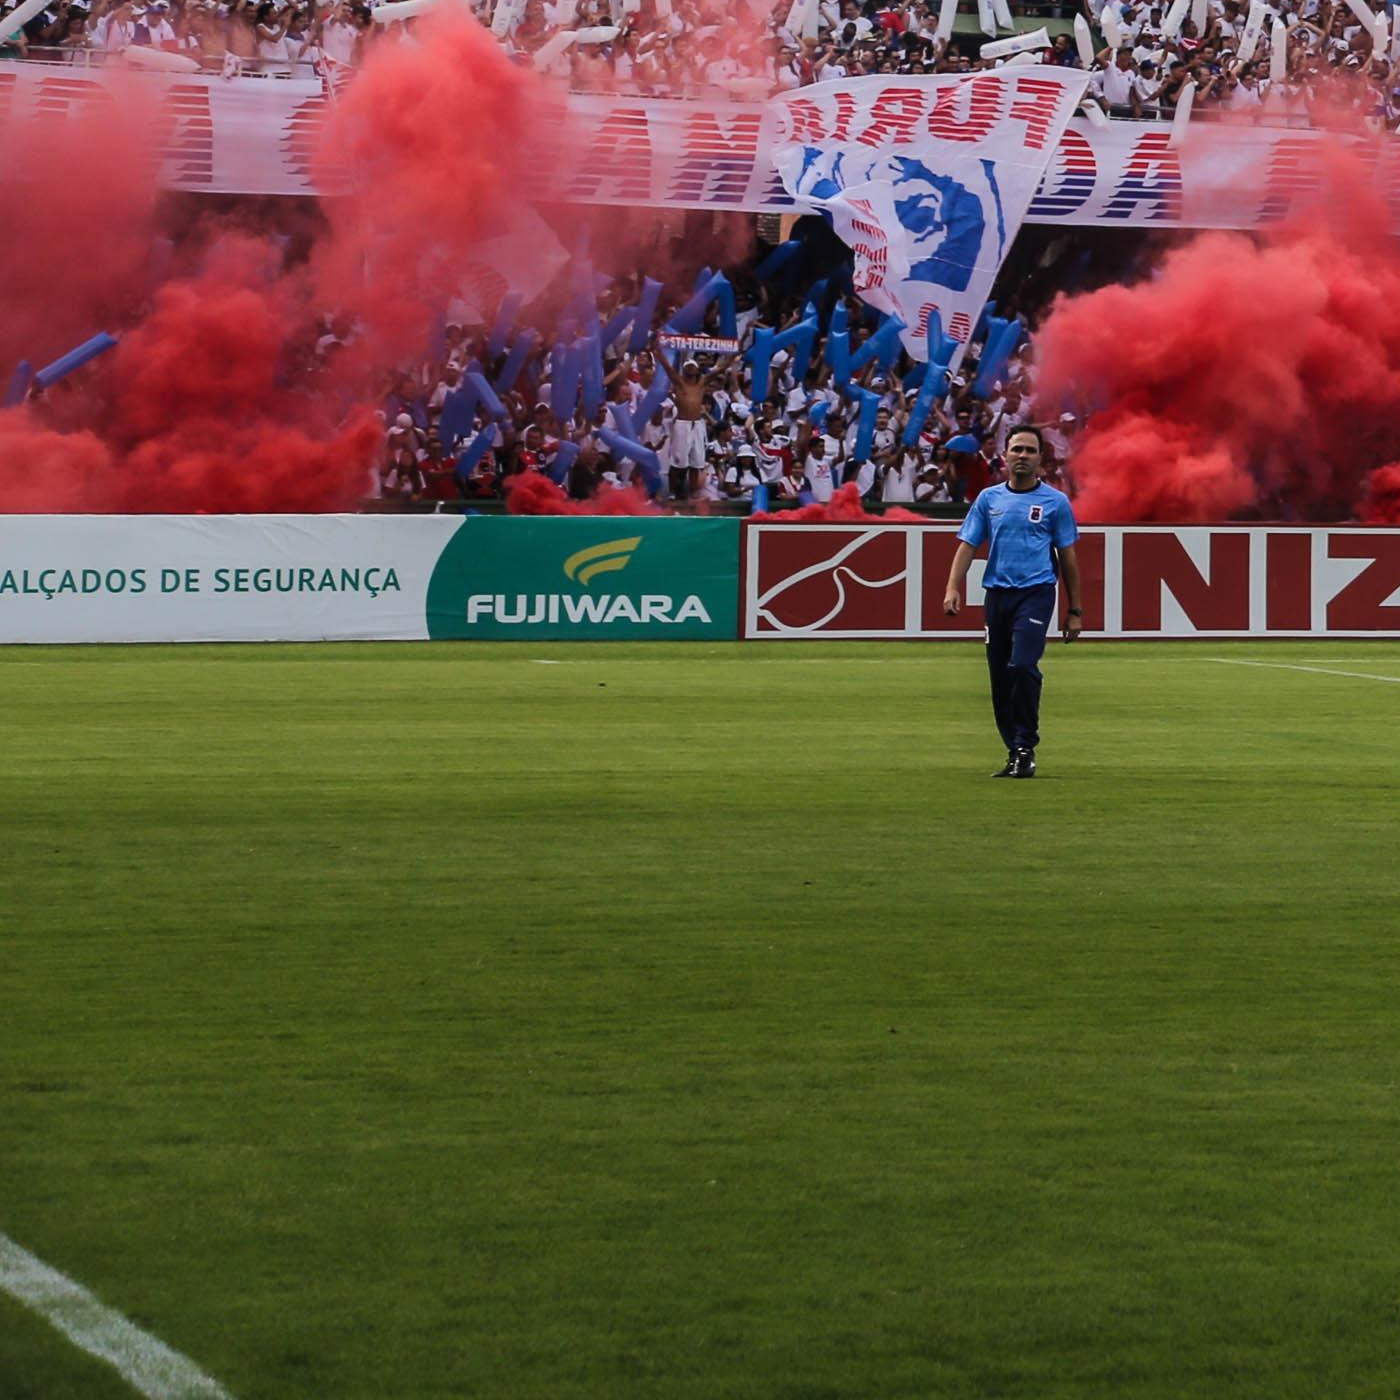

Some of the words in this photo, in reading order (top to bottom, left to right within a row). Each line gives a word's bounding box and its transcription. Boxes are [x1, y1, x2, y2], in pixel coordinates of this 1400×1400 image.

[1, 569, 147, 601] ALÇADOS
[161, 569, 200, 593] DE
[214, 567, 400, 597] SEGURANÇA
[467, 595, 712, 624] FUJIWARA
